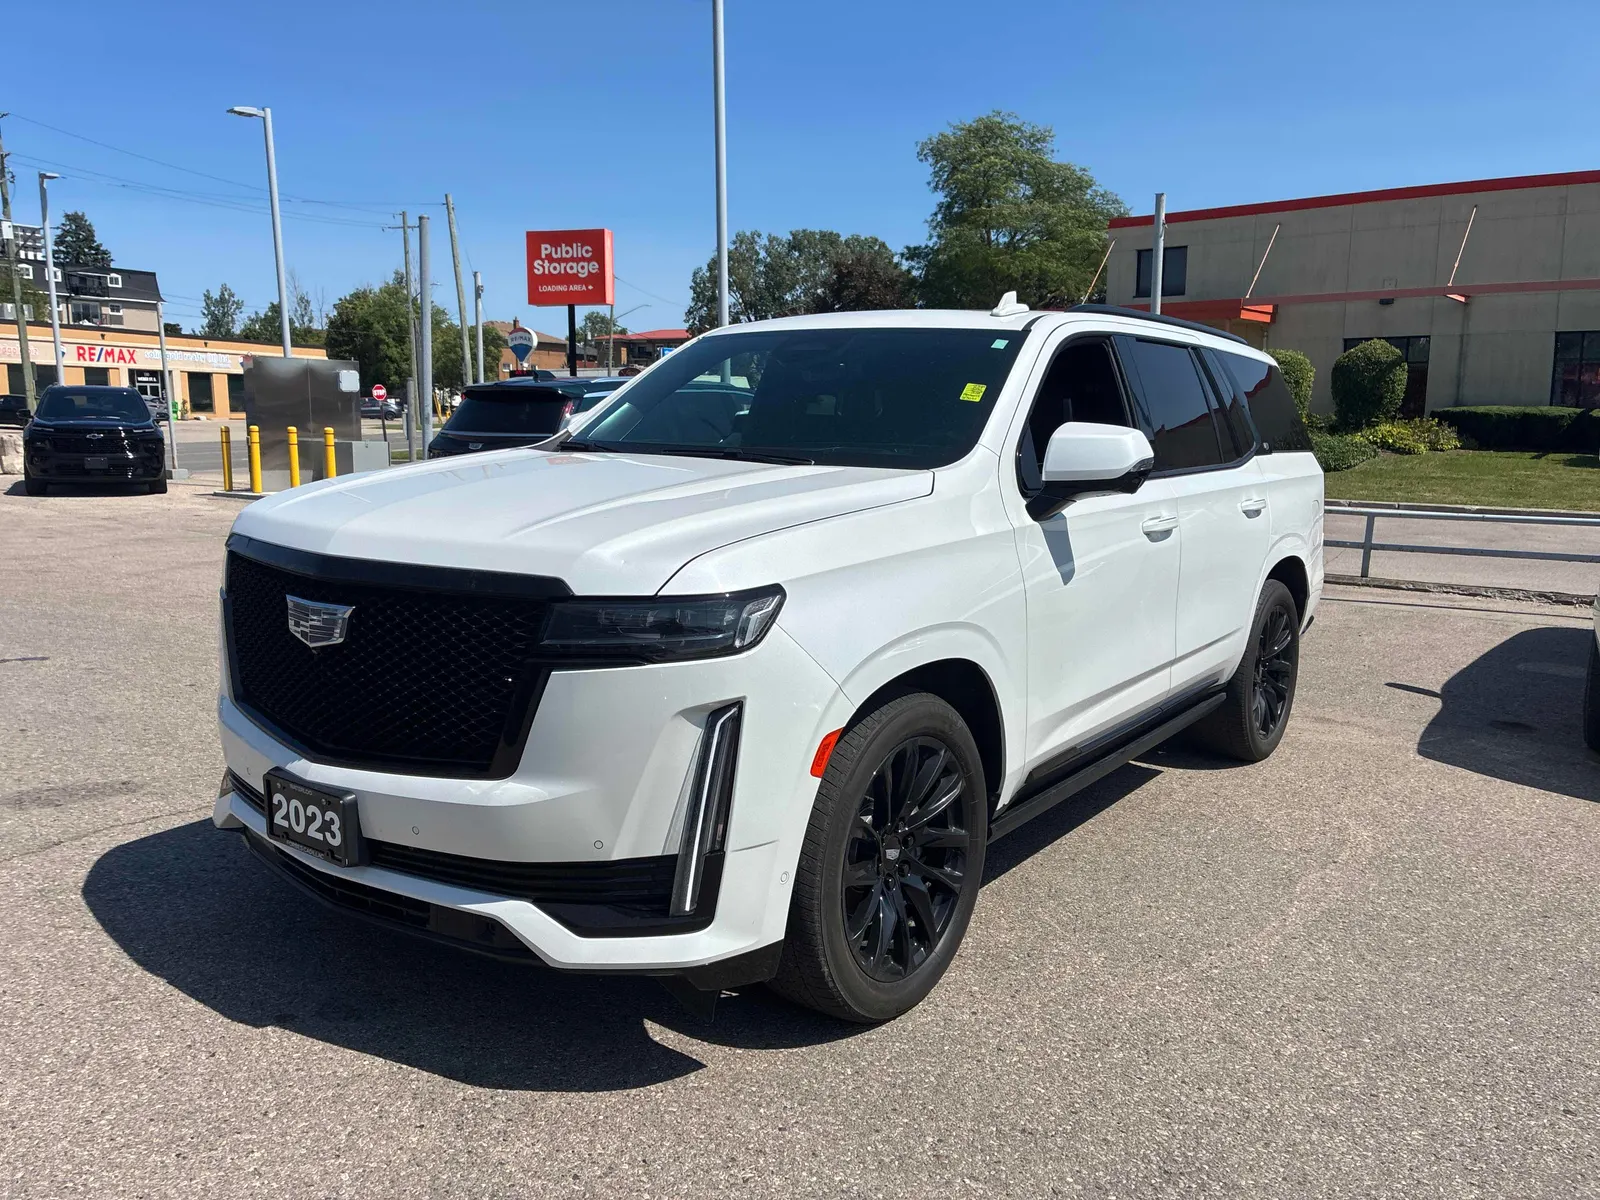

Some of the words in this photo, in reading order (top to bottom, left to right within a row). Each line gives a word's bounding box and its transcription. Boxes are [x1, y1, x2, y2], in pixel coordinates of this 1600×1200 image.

[541, 243, 592, 258] Public
[533, 260, 599, 278] Storage
[76, 345, 137, 364] RE/MAX
[272, 793, 342, 847] 2023
